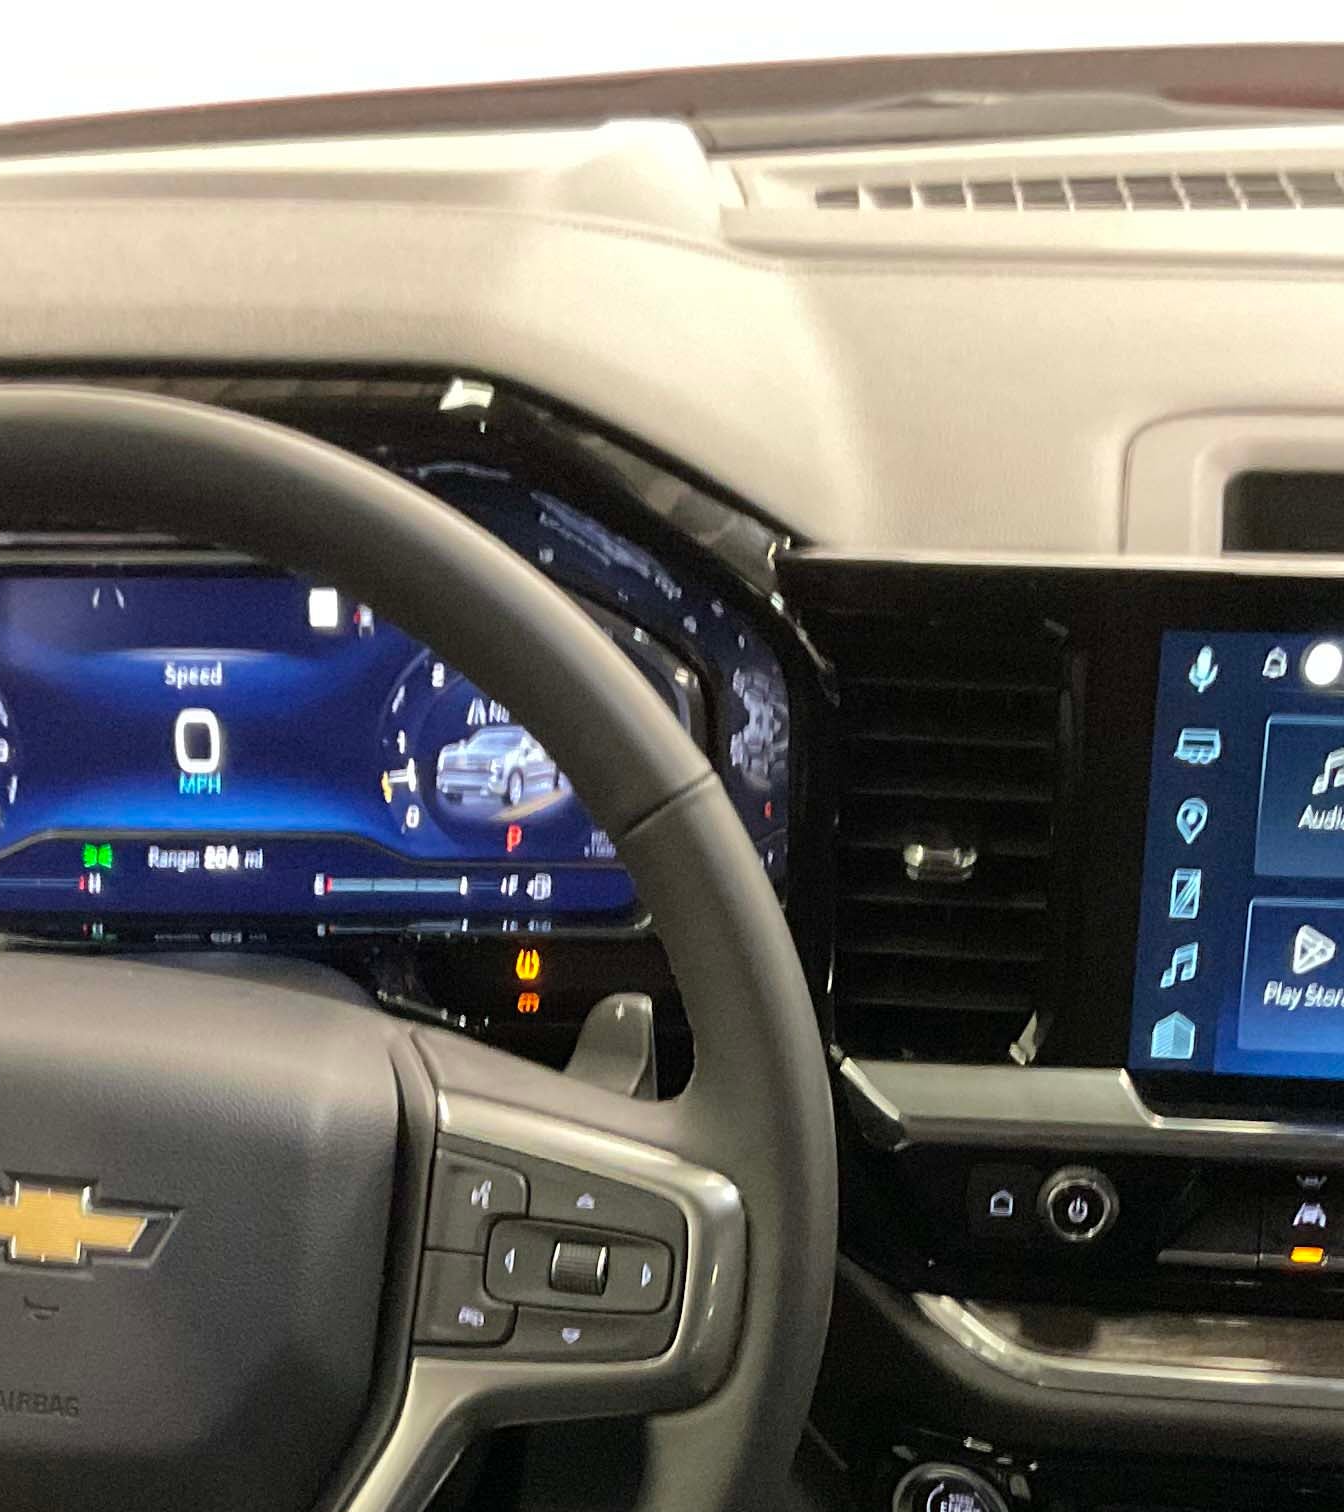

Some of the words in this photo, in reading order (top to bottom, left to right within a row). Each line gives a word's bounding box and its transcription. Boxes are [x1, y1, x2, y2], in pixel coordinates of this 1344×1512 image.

[164, 661, 223, 690] Speed
[175, 706, 220, 774] 0
[179, 771, 222, 795] MPH
[1263, 980, 1304, 1011] Play
